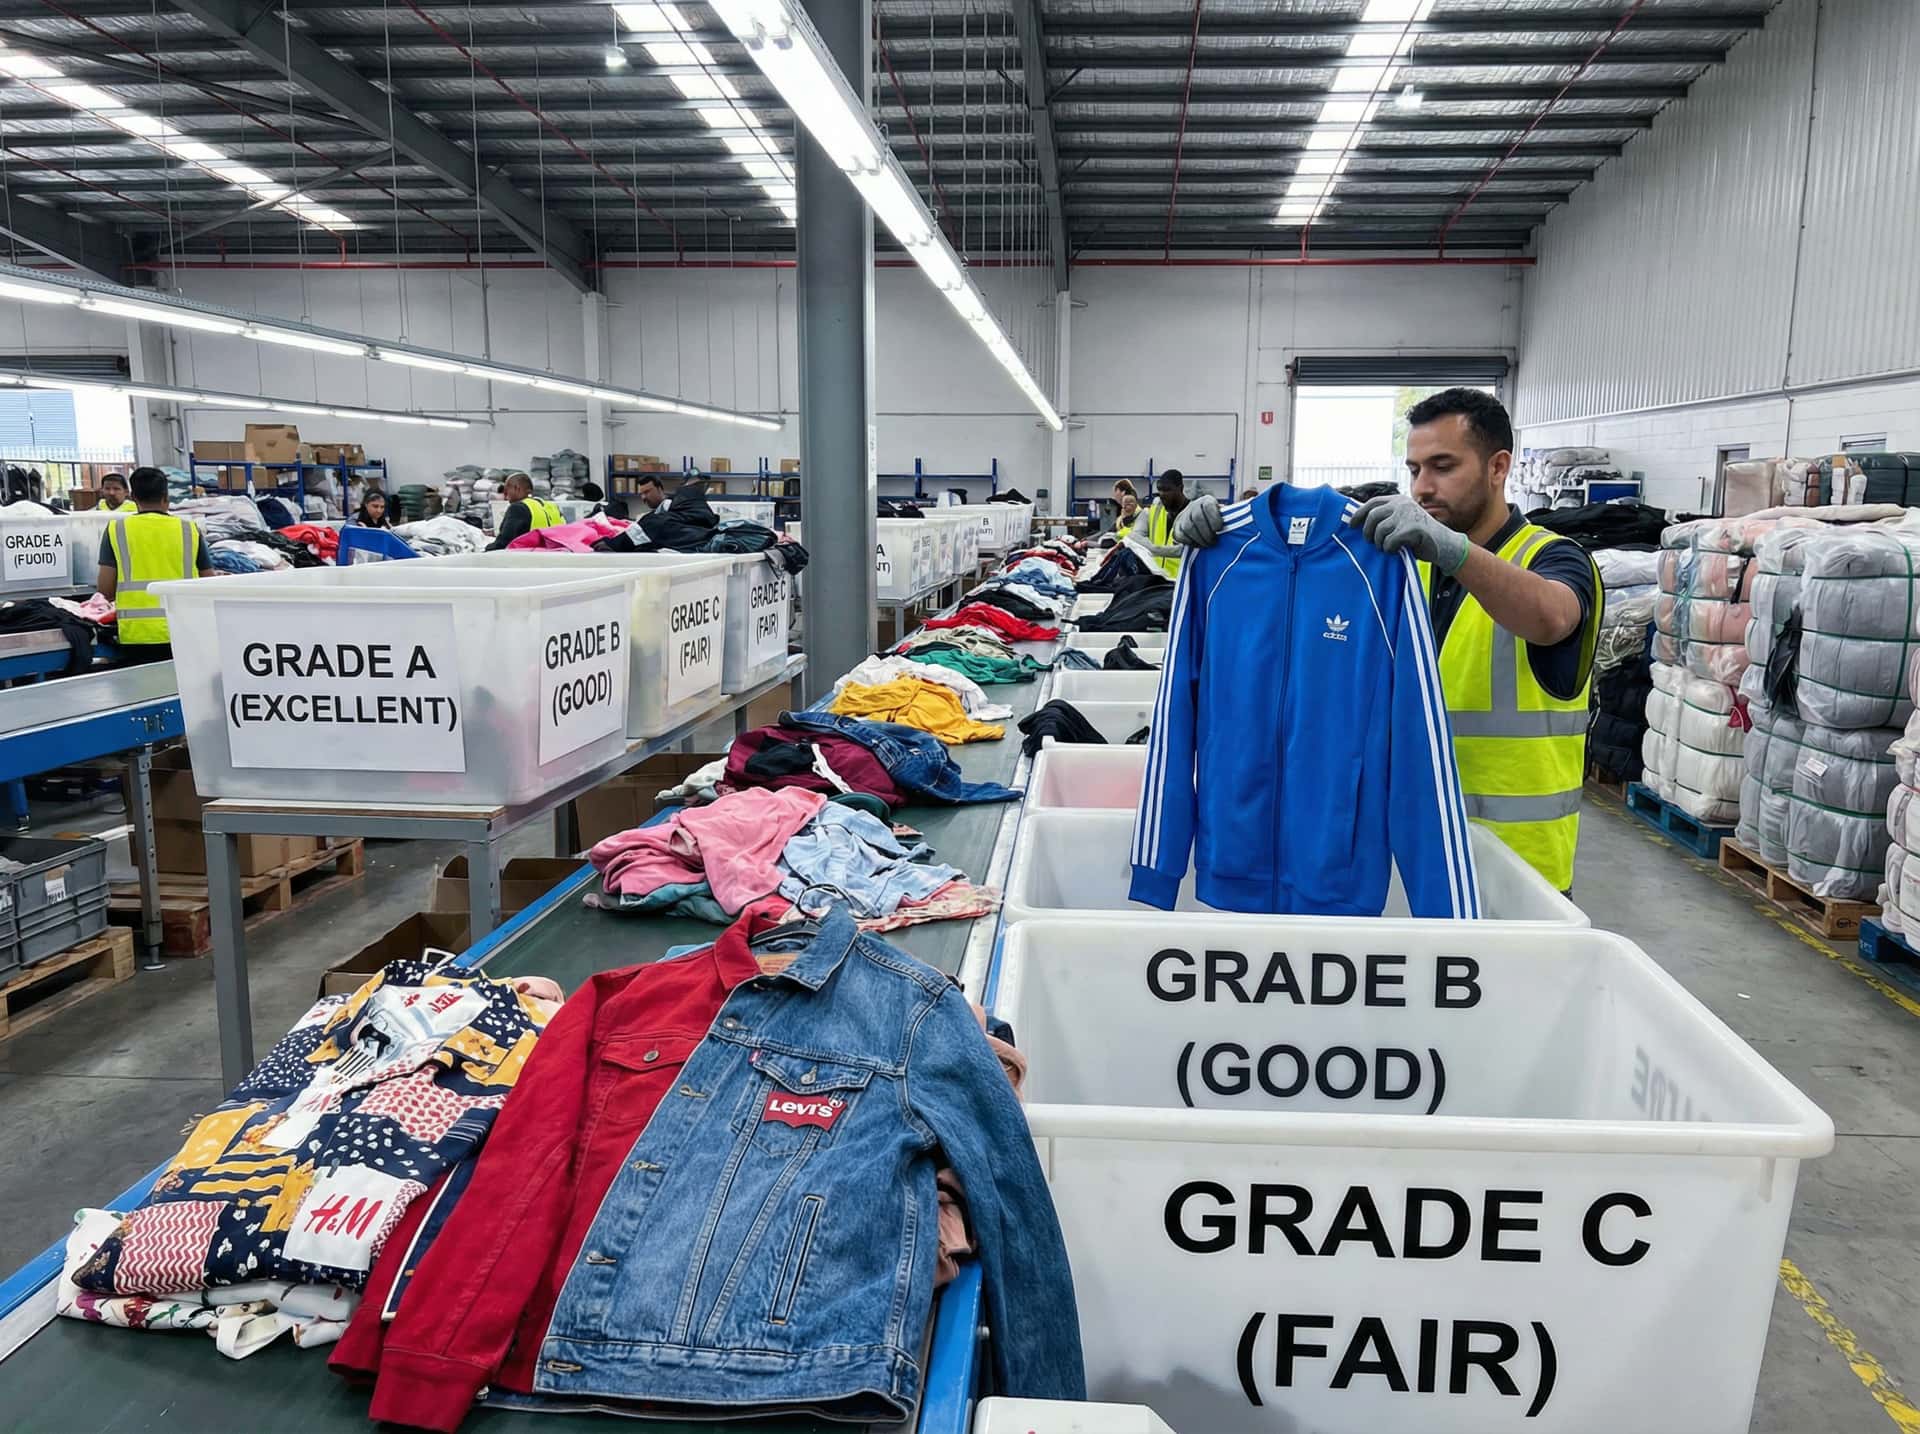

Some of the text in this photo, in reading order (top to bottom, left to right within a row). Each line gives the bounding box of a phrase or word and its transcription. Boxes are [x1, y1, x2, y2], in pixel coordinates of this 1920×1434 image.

[5, 533, 63, 549] GRADE A
[671, 595, 720, 633] GRADE C
[751, 577, 787, 609] GRADE C
[546, 620, 621, 670] GRADE B
[756, 612, 779, 644] (FAIR)
[242, 642, 438, 680] GRADE A
[680, 634, 711, 676] (FAIR)
[230, 693, 458, 733] (EXCELLENT)
[553, 668, 613, 717] (GOOD)
[1146, 948, 1483, 1010] GRADE B
[1176, 1040, 1447, 1115] (GOOD)
[769, 1099, 834, 1118] Levi's
[304, 1194, 384, 1241] H&M
[1163, 1180, 1653, 1267] GRADE C
[1236, 1311, 1558, 1418] (FAIR)
